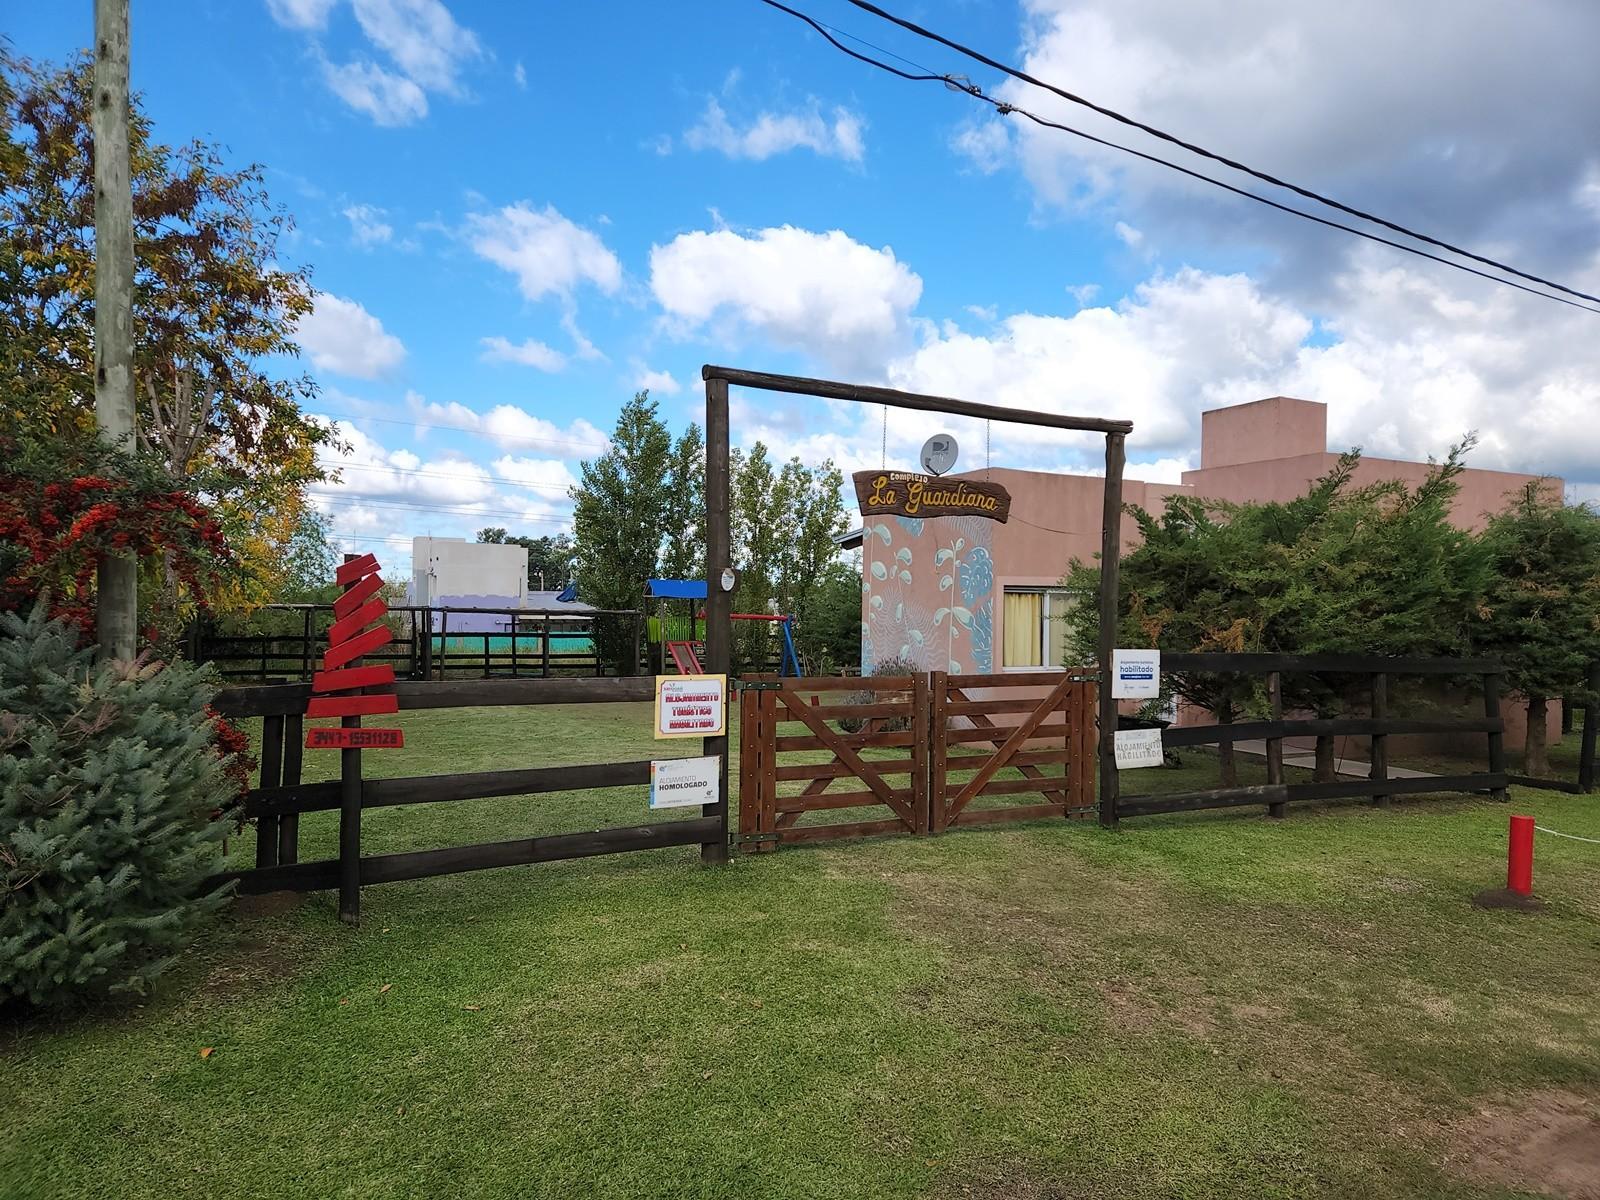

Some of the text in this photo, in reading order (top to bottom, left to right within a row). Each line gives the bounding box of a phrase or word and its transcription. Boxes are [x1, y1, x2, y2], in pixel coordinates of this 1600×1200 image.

[868, 475, 999, 514] La Guardiana
[1120, 665, 1154, 673] habilitado
[1116, 741, 1161, 752] ALOJAMIENTO
[1116, 750, 1161, 761] HABILITADO
[659, 776, 697, 784] ALOJAMIENTO
[659, 781, 708, 791] HOMOLOGADO
